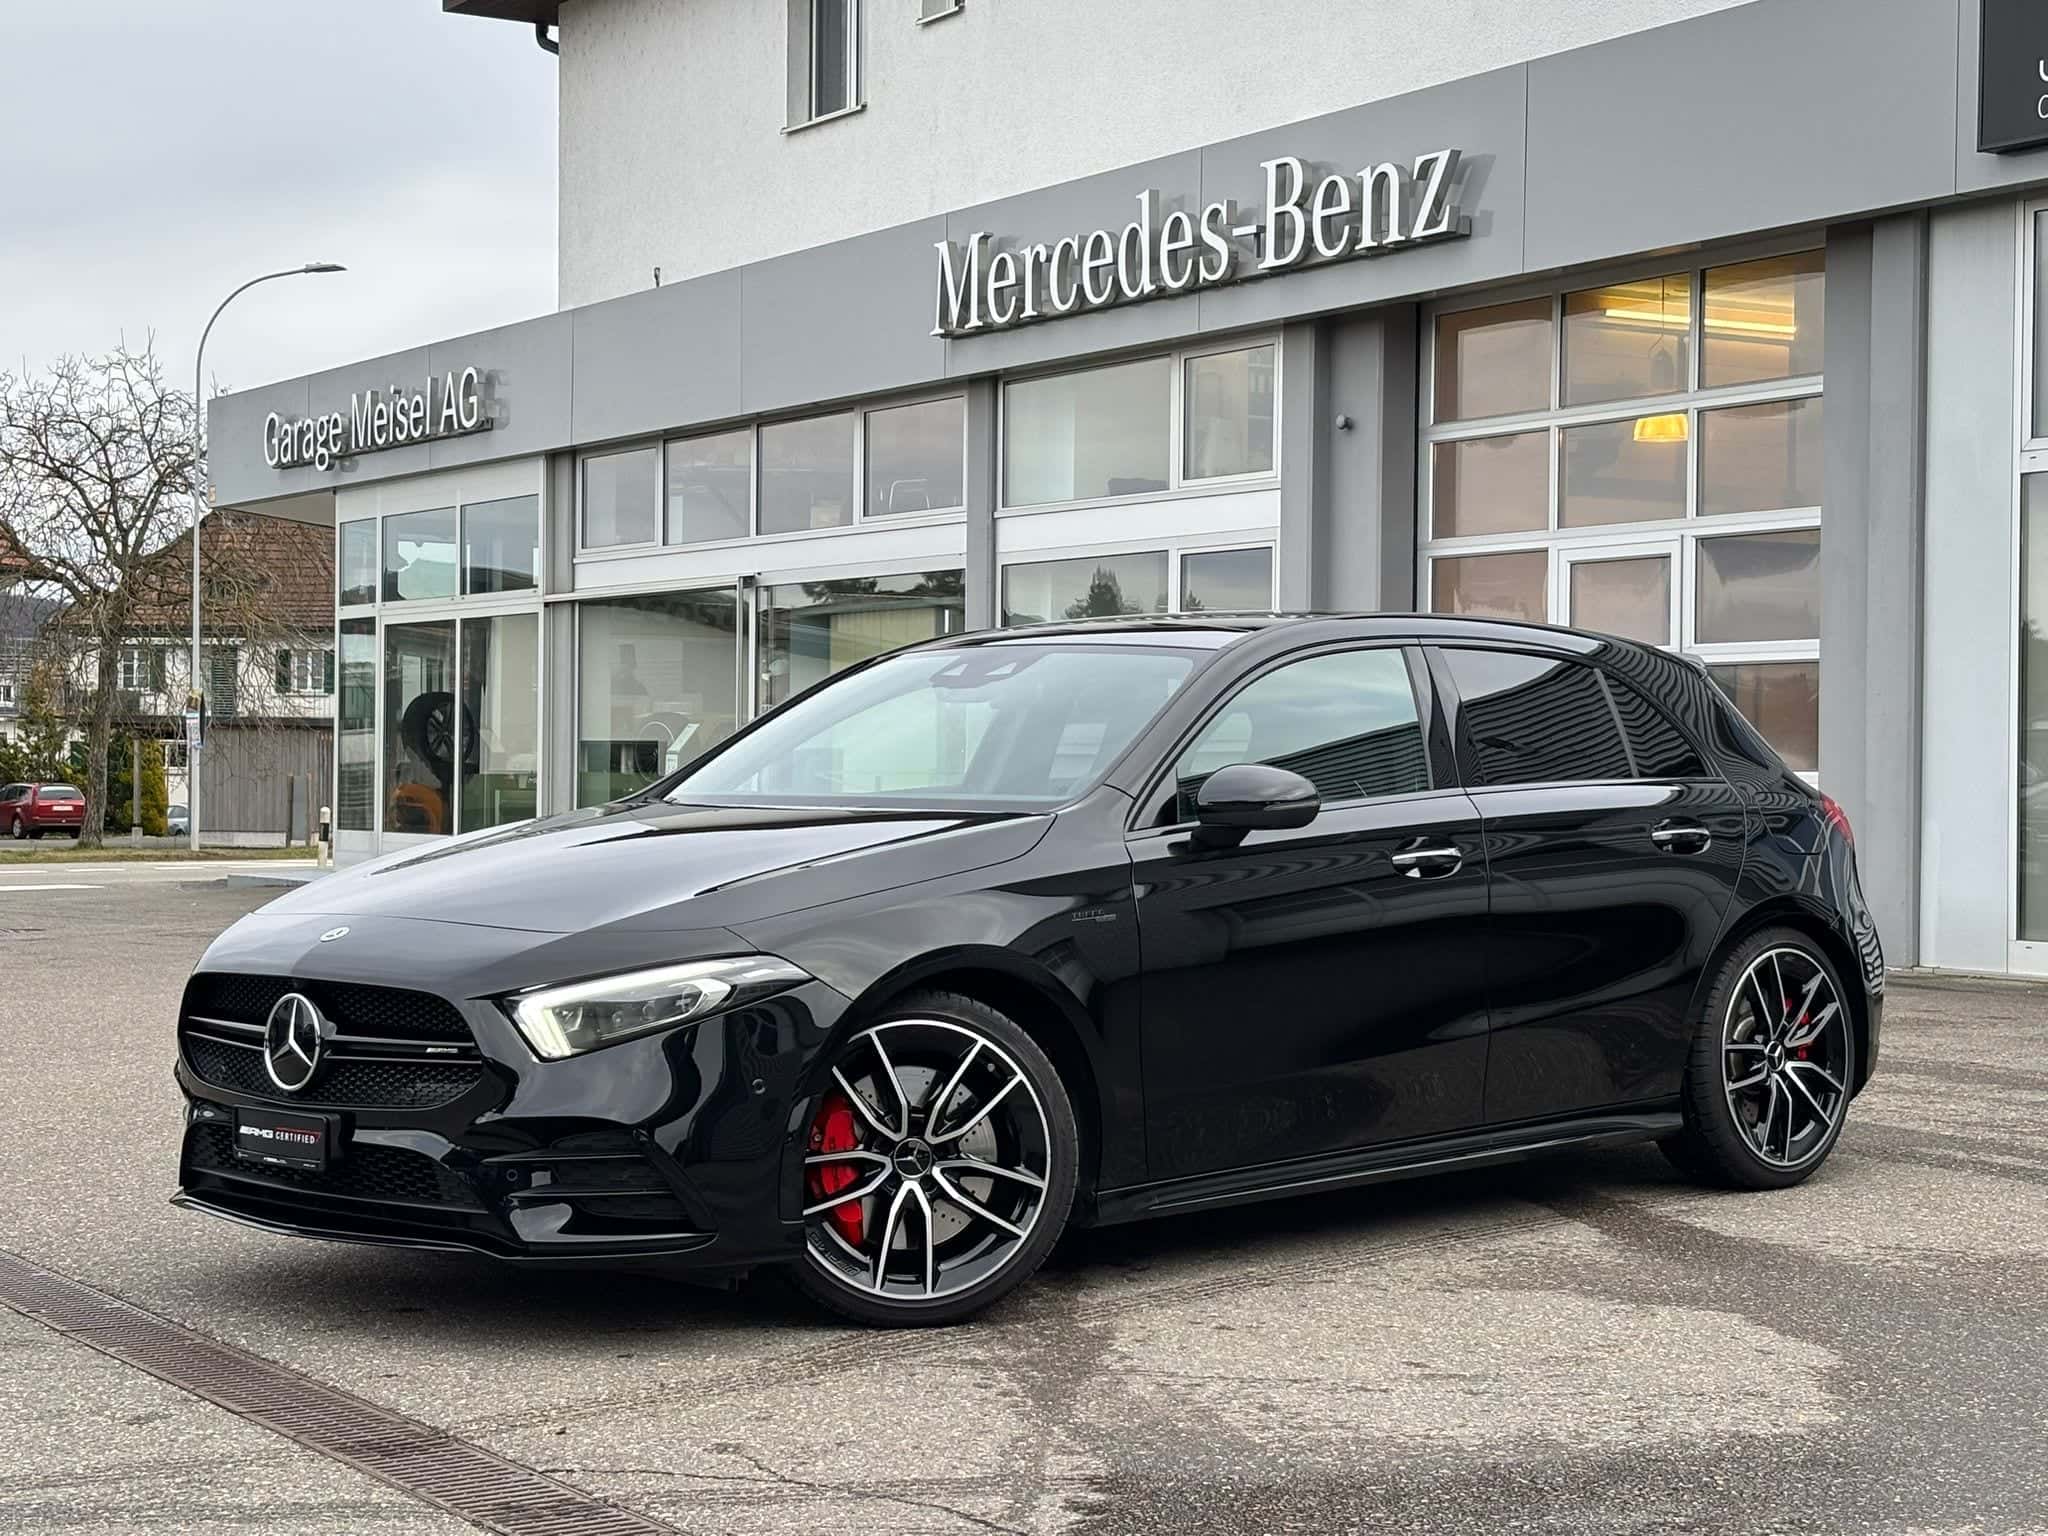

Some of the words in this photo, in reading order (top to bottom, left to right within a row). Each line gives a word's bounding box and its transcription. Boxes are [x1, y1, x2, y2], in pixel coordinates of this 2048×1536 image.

[930, 148, 1462, 336] Mercedes-Benz
[263, 411, 343, 471] Garage
[351, 375, 432, 450] Meisel
[439, 366, 479, 433] AG
[275, 1131, 316, 1145] CERTIFIED
